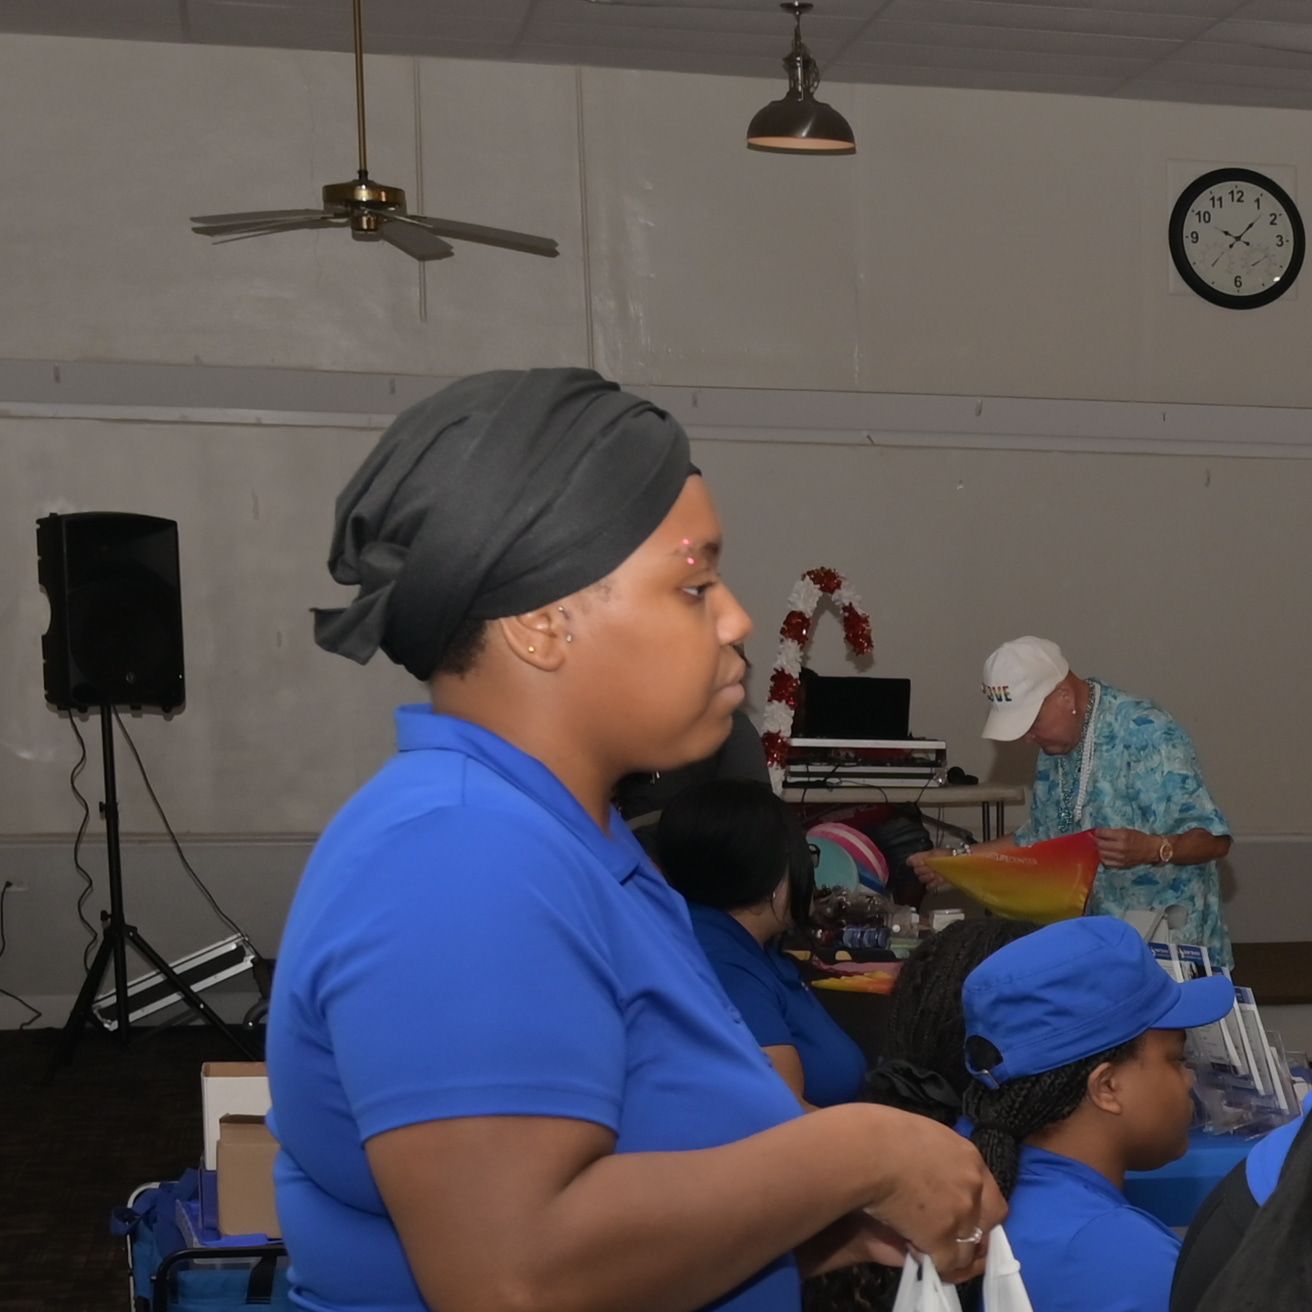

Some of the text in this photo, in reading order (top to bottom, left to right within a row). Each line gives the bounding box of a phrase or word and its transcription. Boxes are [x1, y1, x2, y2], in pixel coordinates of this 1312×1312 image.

[1209, 196, 1224, 209] 11
[1228, 189, 1245, 204] 12
[1254, 198, 1262, 210] 1
[1195, 210, 1211, 224] 10
[1269, 213, 1278, 226] 2
[1190, 231, 1199, 244] 9
[1275, 234, 1284, 248] 3
[1234, 275, 1243, 289] 6
